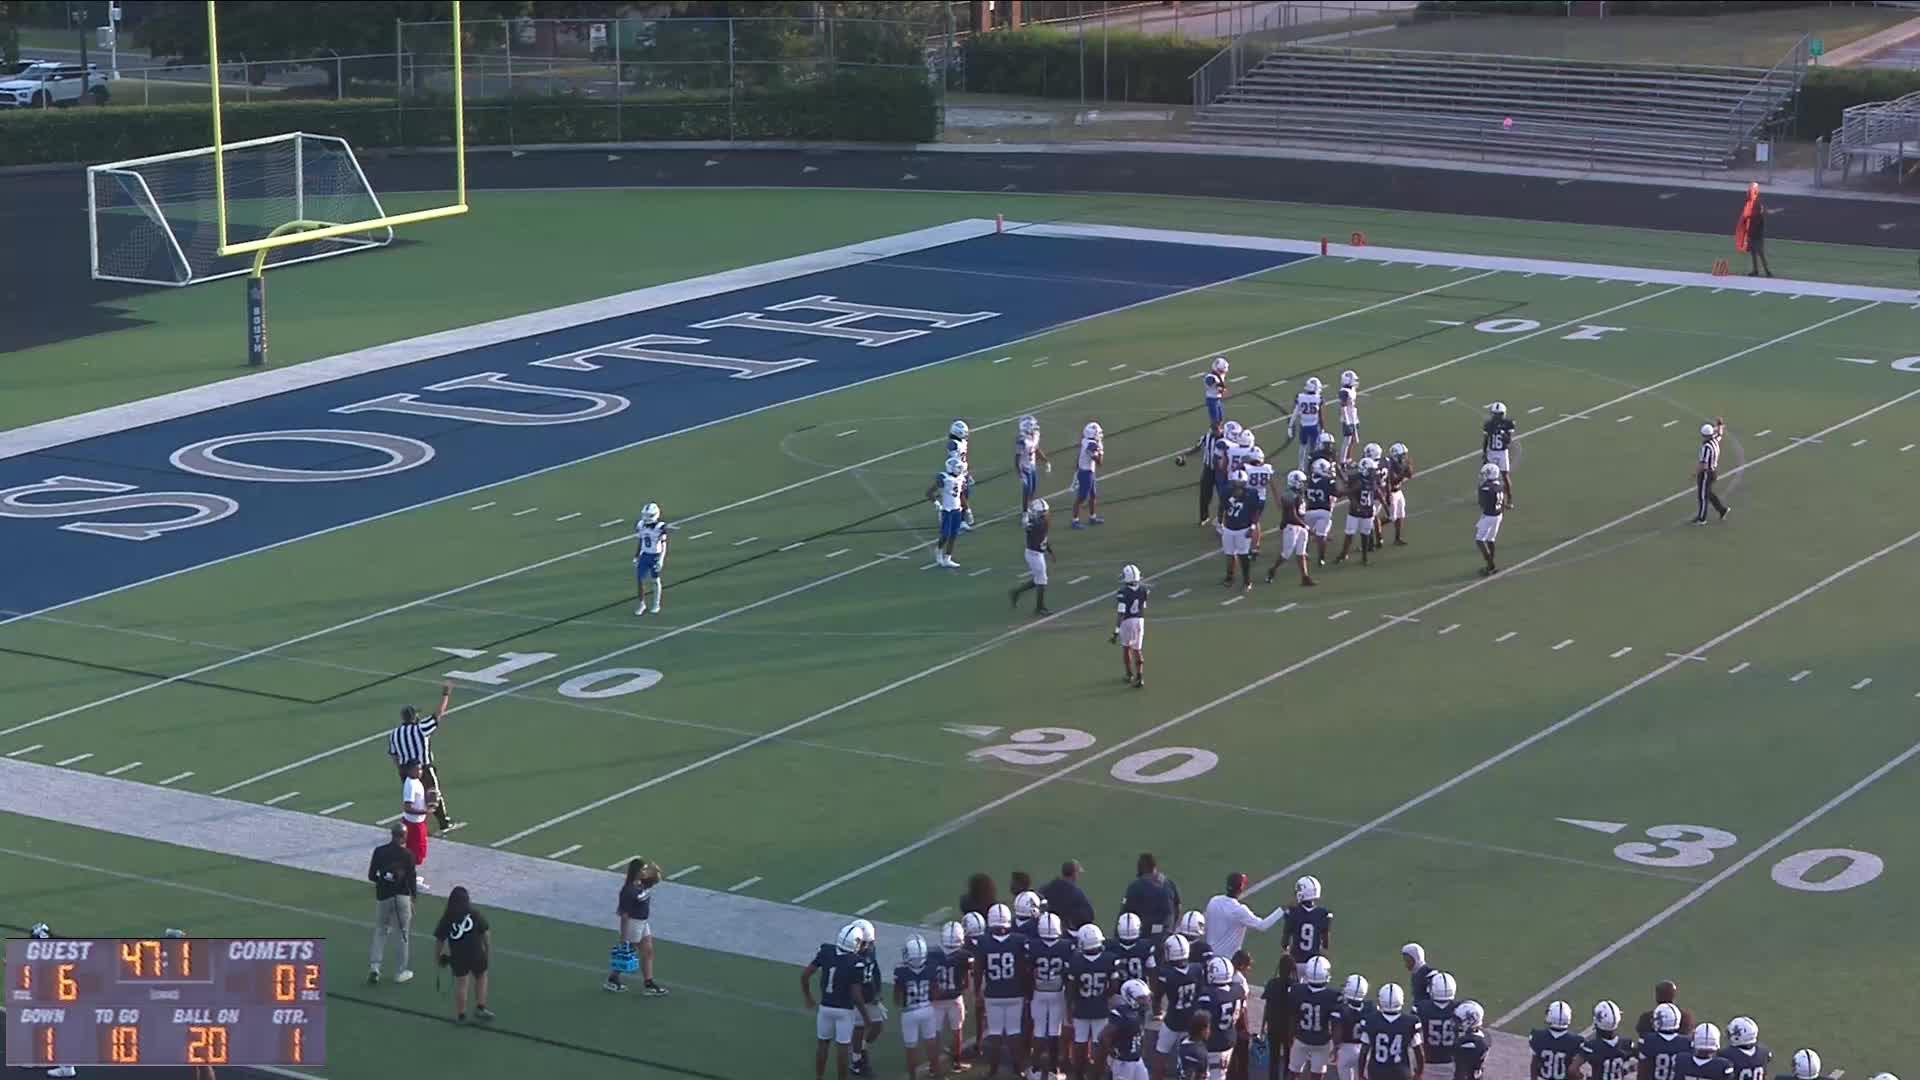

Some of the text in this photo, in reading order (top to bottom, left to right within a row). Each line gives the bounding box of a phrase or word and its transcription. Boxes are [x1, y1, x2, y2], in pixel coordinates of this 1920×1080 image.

[253, 307, 262, 352] SOUTH
[0, 295, 998, 540] SOUTH
[1250, 473, 1268, 486] 88
[1130, 599, 1140, 615] 4
[441, 652, 664, 698] 10
[964, 727, 1219, 784] 20
[1613, 824, 1884, 892] 30
[1300, 923, 1314, 951] 9
[826, 967, 836, 993] 1
[987, 952, 1015, 981] 58
[1079, 972, 1107, 998] 35
[1300, 1002, 1322, 1031] 31
[1375, 1032, 1403, 1063] 64
[1540, 1050, 1567, 1080] 30
